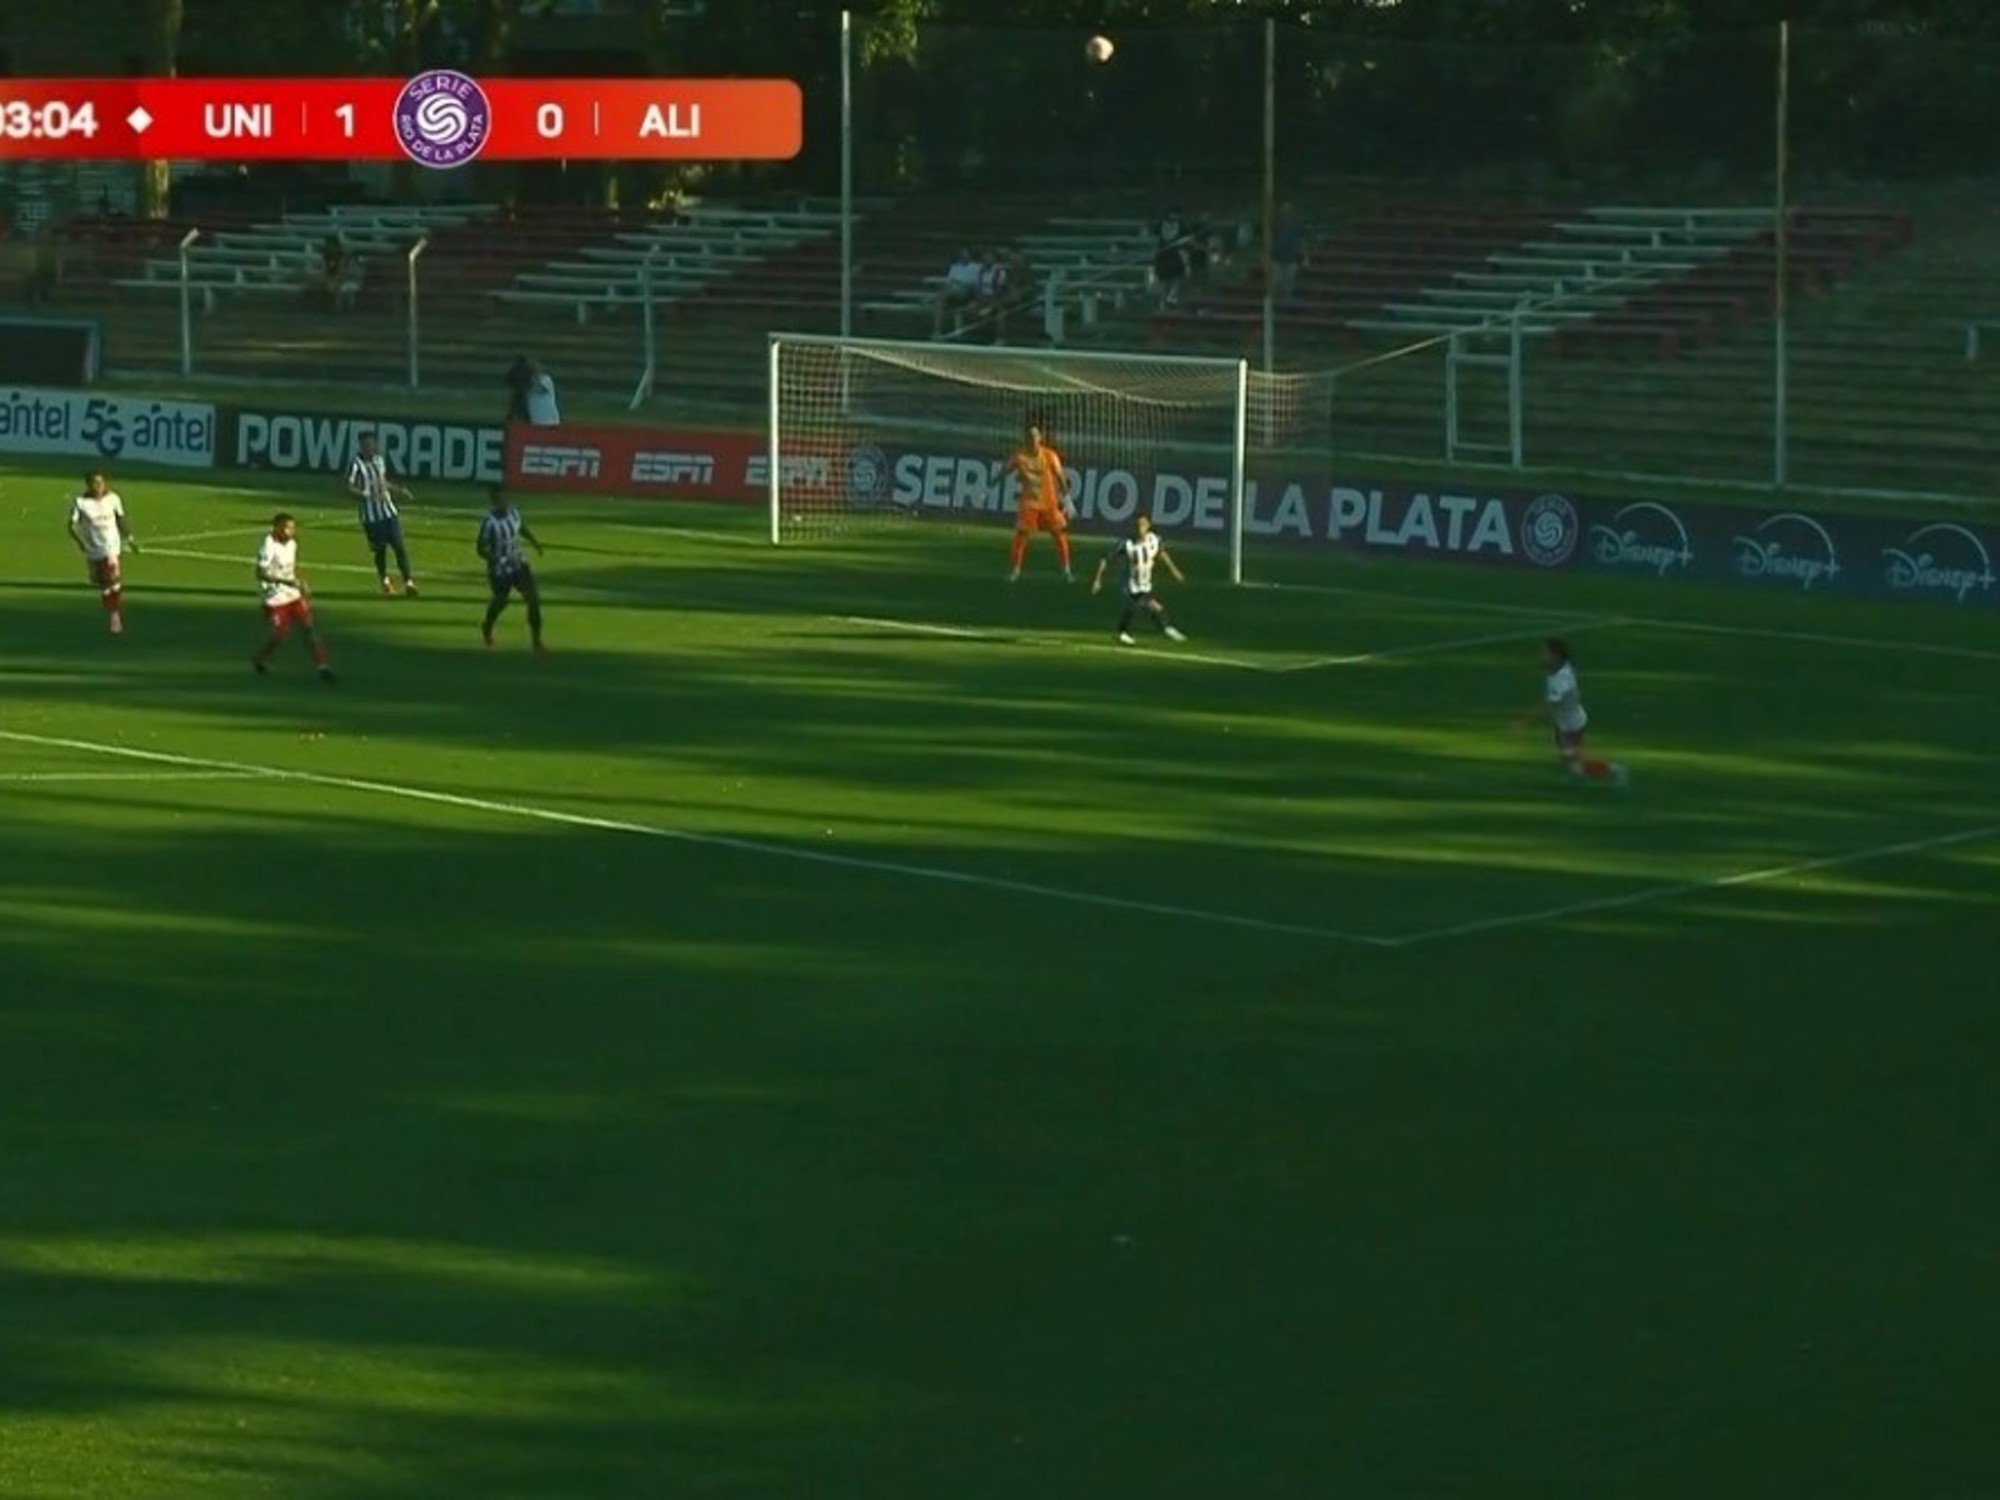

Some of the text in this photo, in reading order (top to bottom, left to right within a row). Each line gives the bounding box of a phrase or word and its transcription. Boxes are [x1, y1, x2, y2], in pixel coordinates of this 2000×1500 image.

[81, 400, 125, 457] 5G
[133, 404, 213, 455] antel
[521, 446, 601, 479] ESPN
[631, 452, 715, 485] ESPN
[1151, 474, 1229, 530] DE
[1243, 482, 1313, 538] LA
[1327, 487, 1513, 555] PLATA
